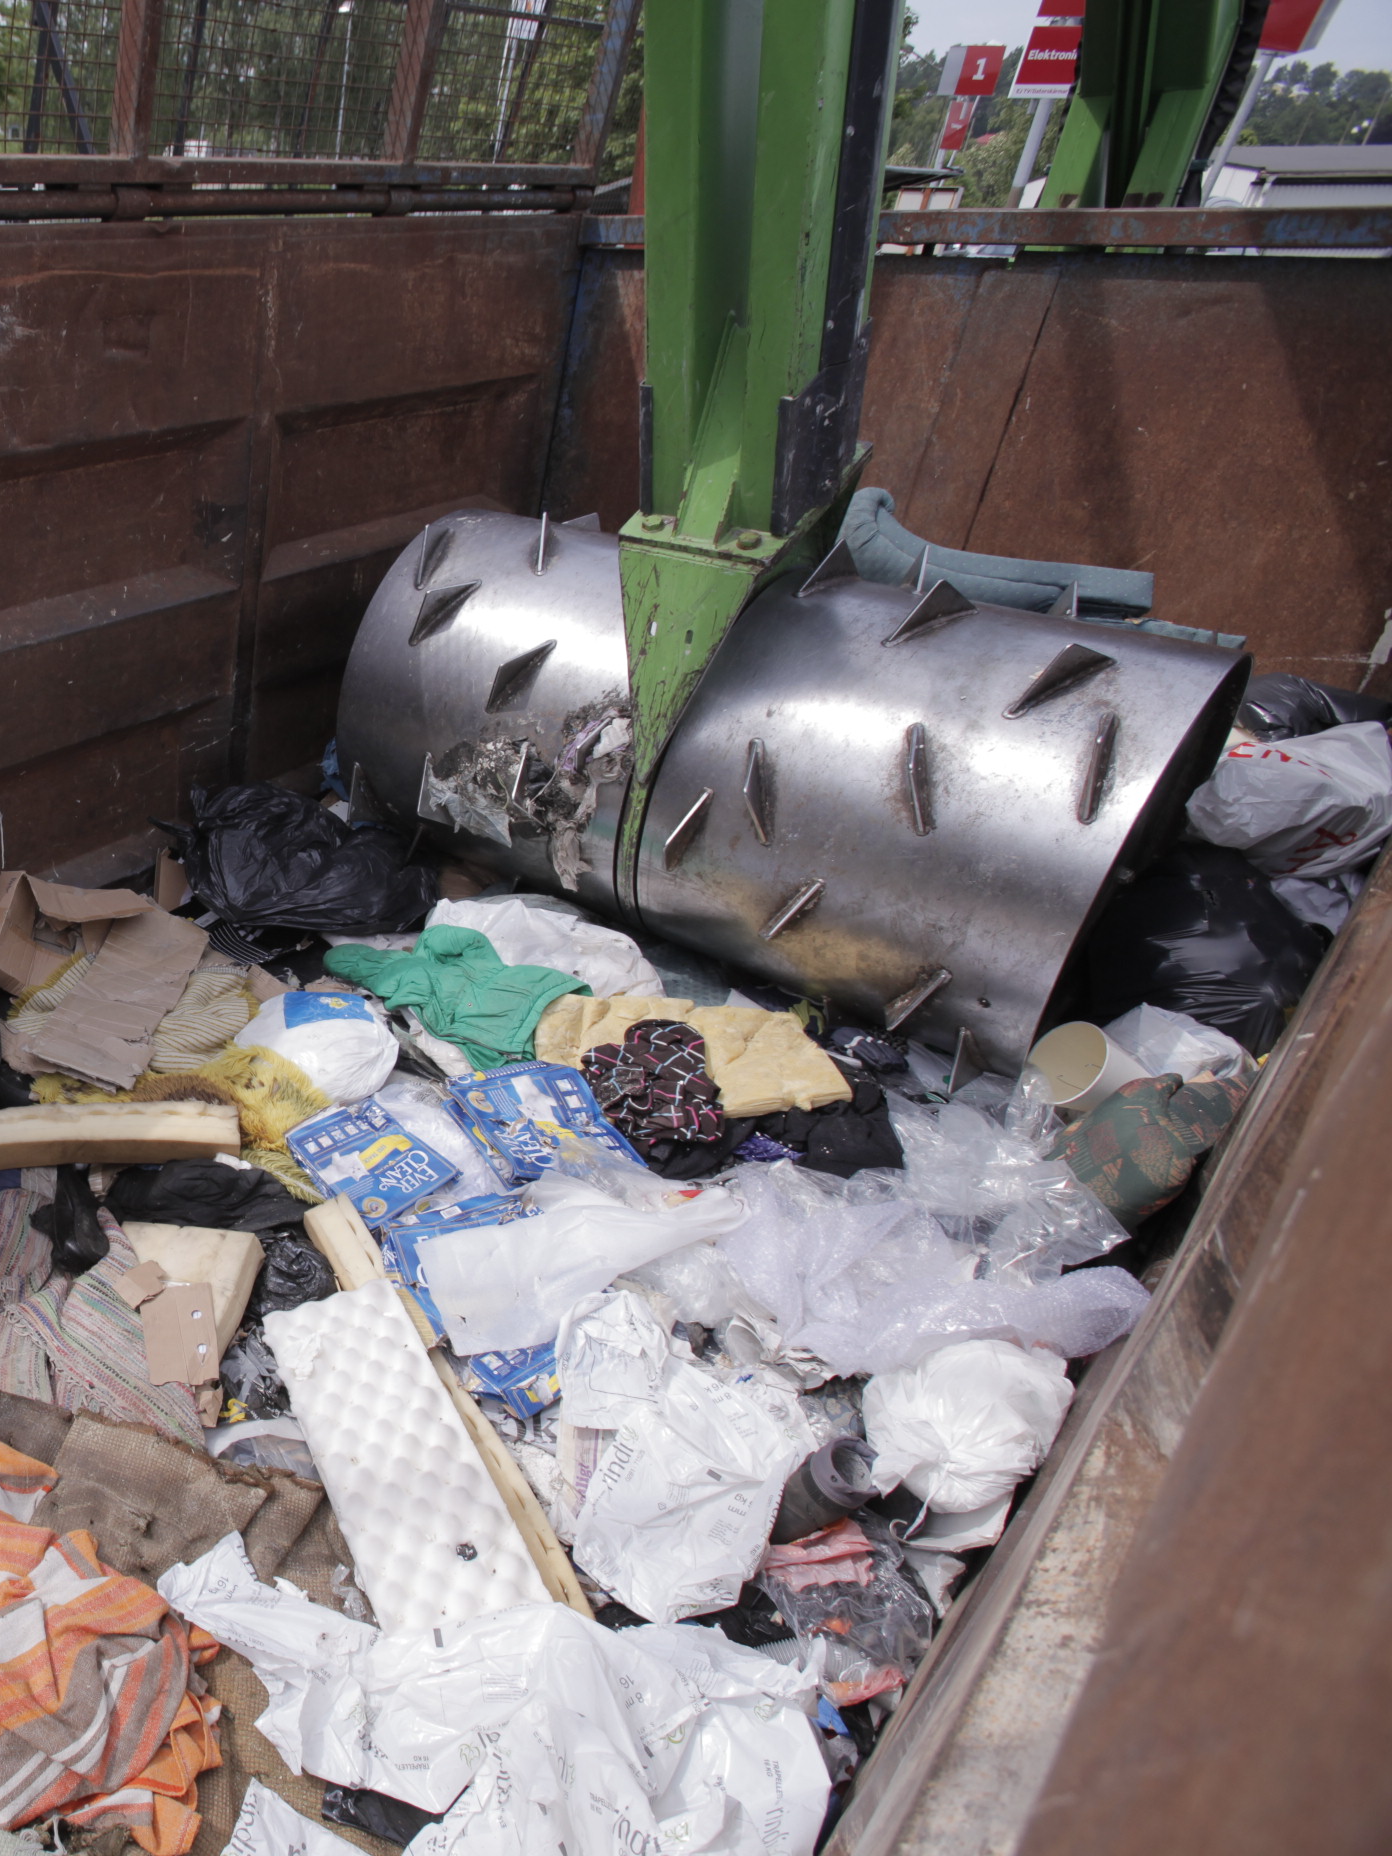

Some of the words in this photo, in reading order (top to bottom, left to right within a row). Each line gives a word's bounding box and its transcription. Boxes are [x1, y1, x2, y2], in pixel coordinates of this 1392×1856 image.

[972, 57, 987, 80] 1
[379, 1150, 429, 1191] CLEAN
[402, 1163, 439, 1194] EVER
[599, 1438, 635, 1492] rindi
[217, 1576, 229, 1589] 16
[619, 1675, 635, 1690] 16
[766, 1806, 790, 1850] rindi
